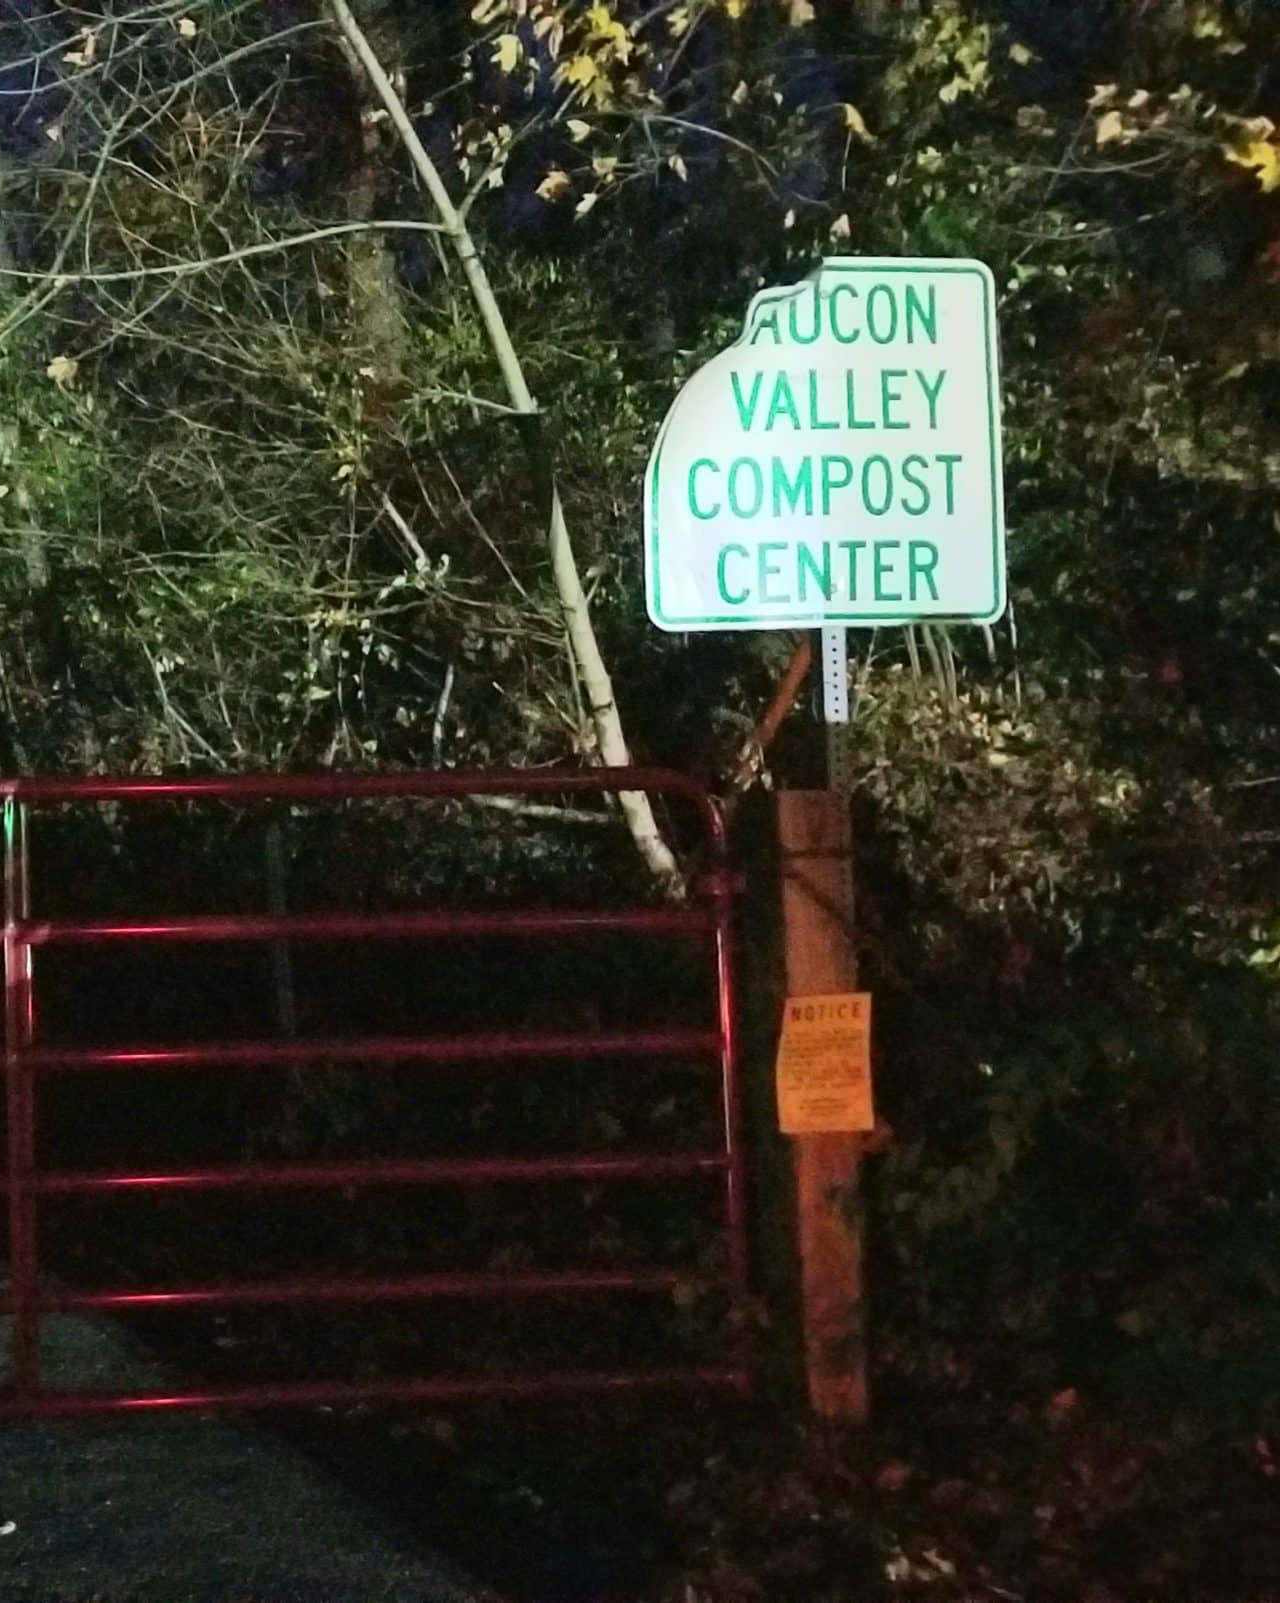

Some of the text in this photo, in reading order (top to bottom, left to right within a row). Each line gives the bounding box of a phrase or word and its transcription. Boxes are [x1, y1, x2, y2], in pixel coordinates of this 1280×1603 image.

[730, 369, 947, 431] VALLEY
[687, 455, 963, 521] COMPOST
[717, 540, 940, 606] CENTER
[791, 1001, 862, 1022] NOTICE
